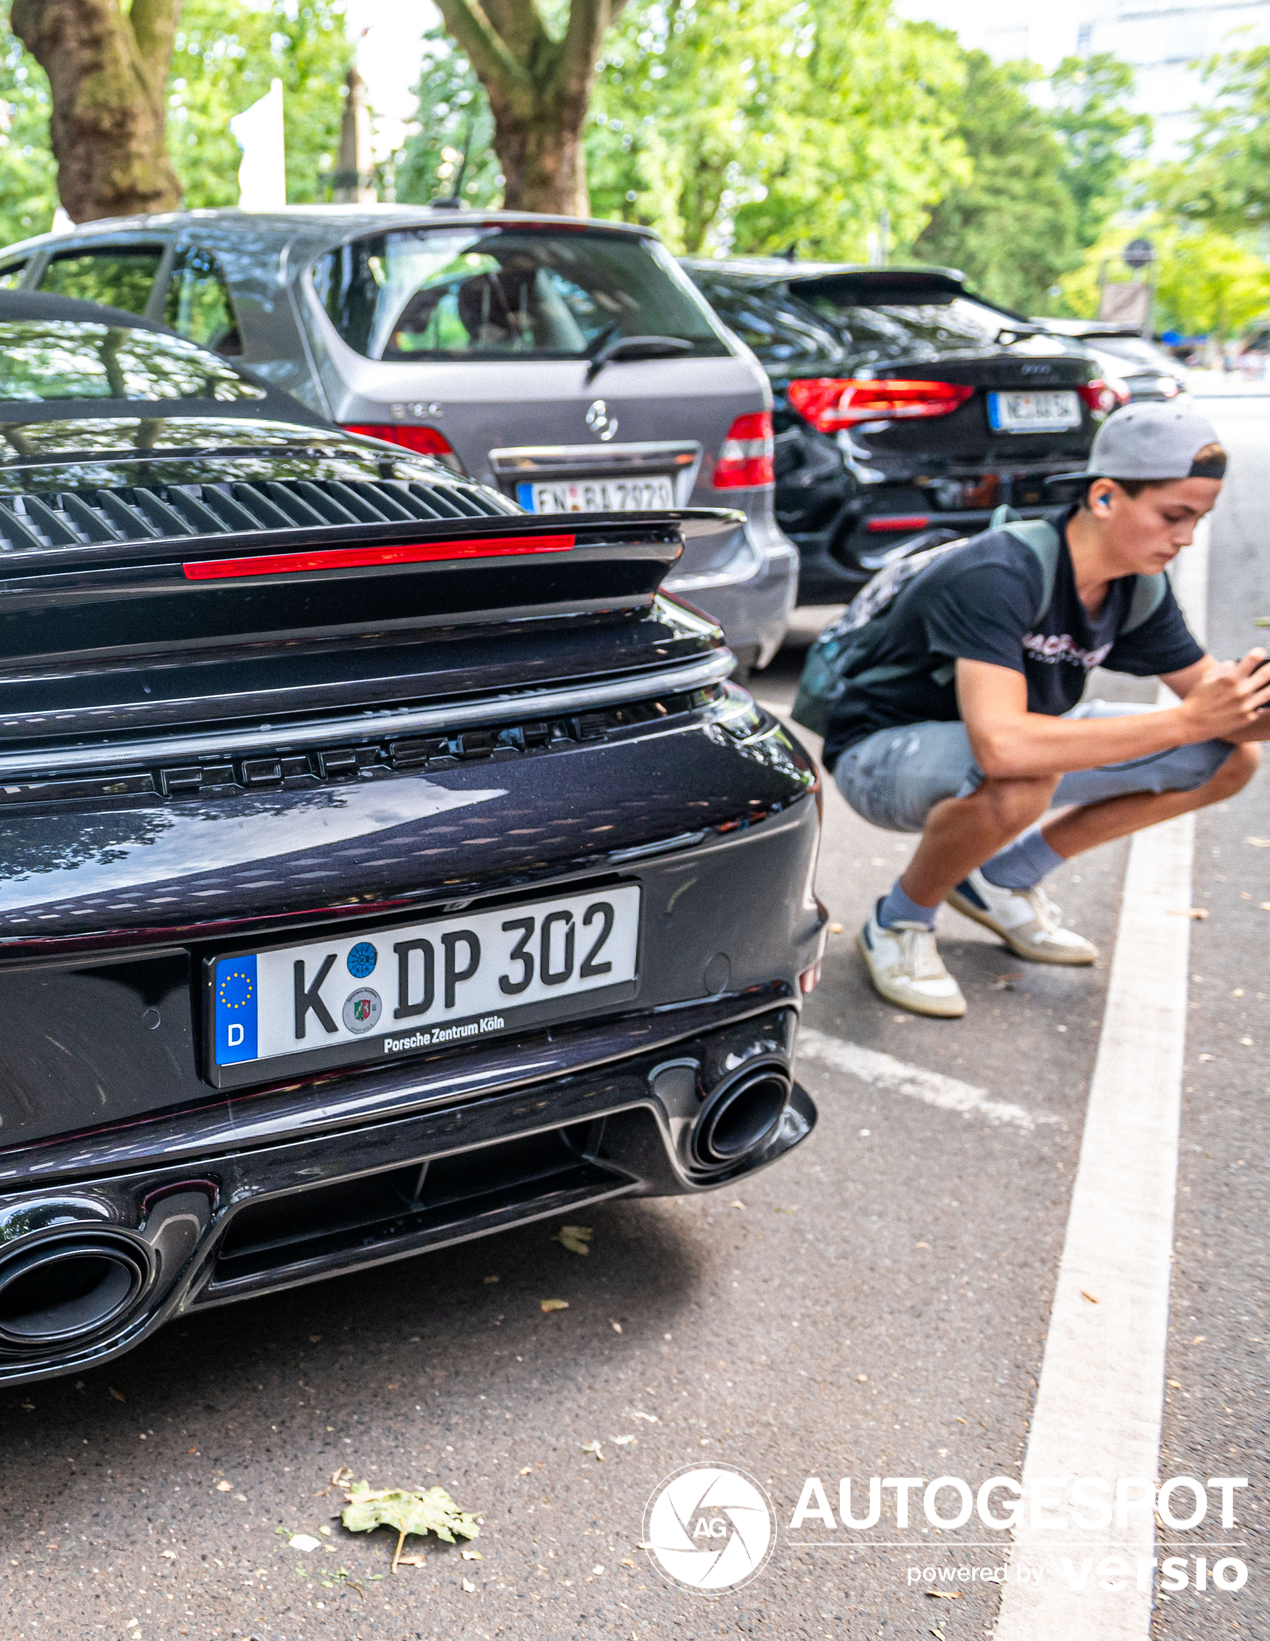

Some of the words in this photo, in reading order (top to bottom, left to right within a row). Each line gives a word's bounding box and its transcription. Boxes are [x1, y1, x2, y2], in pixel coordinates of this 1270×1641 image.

[294, 953, 339, 1040] K
[393, 929, 482, 1020] DP
[498, 901, 615, 995] 302
[227, 1023, 245, 1047] D
[383, 1031, 431, 1054] Porsche
[431, 1022, 480, 1044] Zentrum
[479, 1015, 505, 1033] Köln
